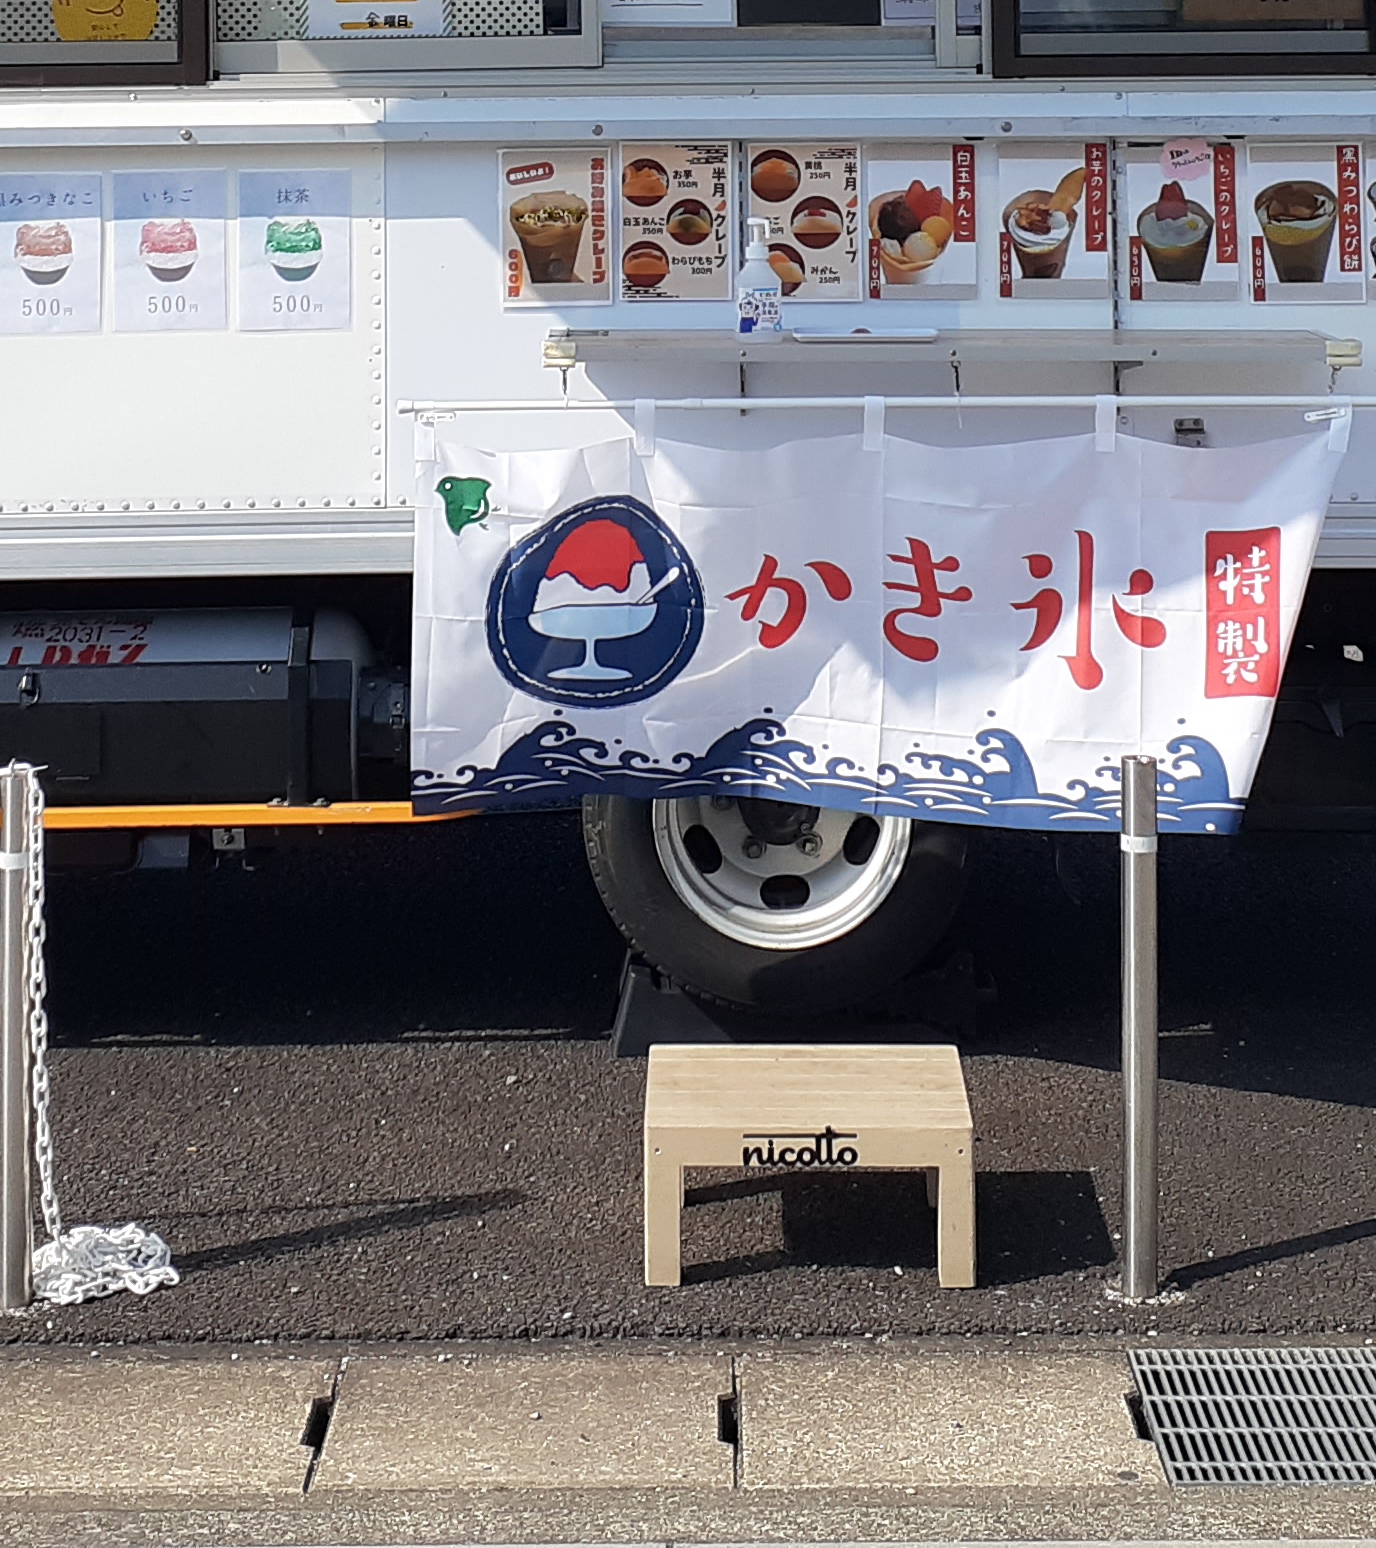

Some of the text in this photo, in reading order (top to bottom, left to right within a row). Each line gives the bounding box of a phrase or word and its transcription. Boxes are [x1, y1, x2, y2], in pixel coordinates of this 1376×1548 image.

[366, 12, 409, 27] 金曜日
[141, 189, 193, 203] いちご
[276, 188, 311, 204] 抹茶
[956, 151, 972, 236] 白玉あんこ
[1090, 147, 1104, 245] お芋のクレープ
[1217, 152, 1233, 258] いちごのクレープ
[1342, 147, 1360, 270] 黒みつわらび餅
[623, 218, 666, 227] 白玉あんこ
[671, 256, 713, 267] わらびもち
[810, 266, 838, 275] みかん
[870, 246, 880, 290] 700円
[1001, 241, 1011, 285] 700円
[1254, 247, 1265, 289] 600円
[22, 299, 73, 317] 500円
[147, 294, 199, 313] 500円
[272, 294, 323, 313] 500円
[725, 528, 1167, 691] かき氷
[1214, 546, 1271, 685] 特製
[742, 1125, 859, 1166] nicotto
